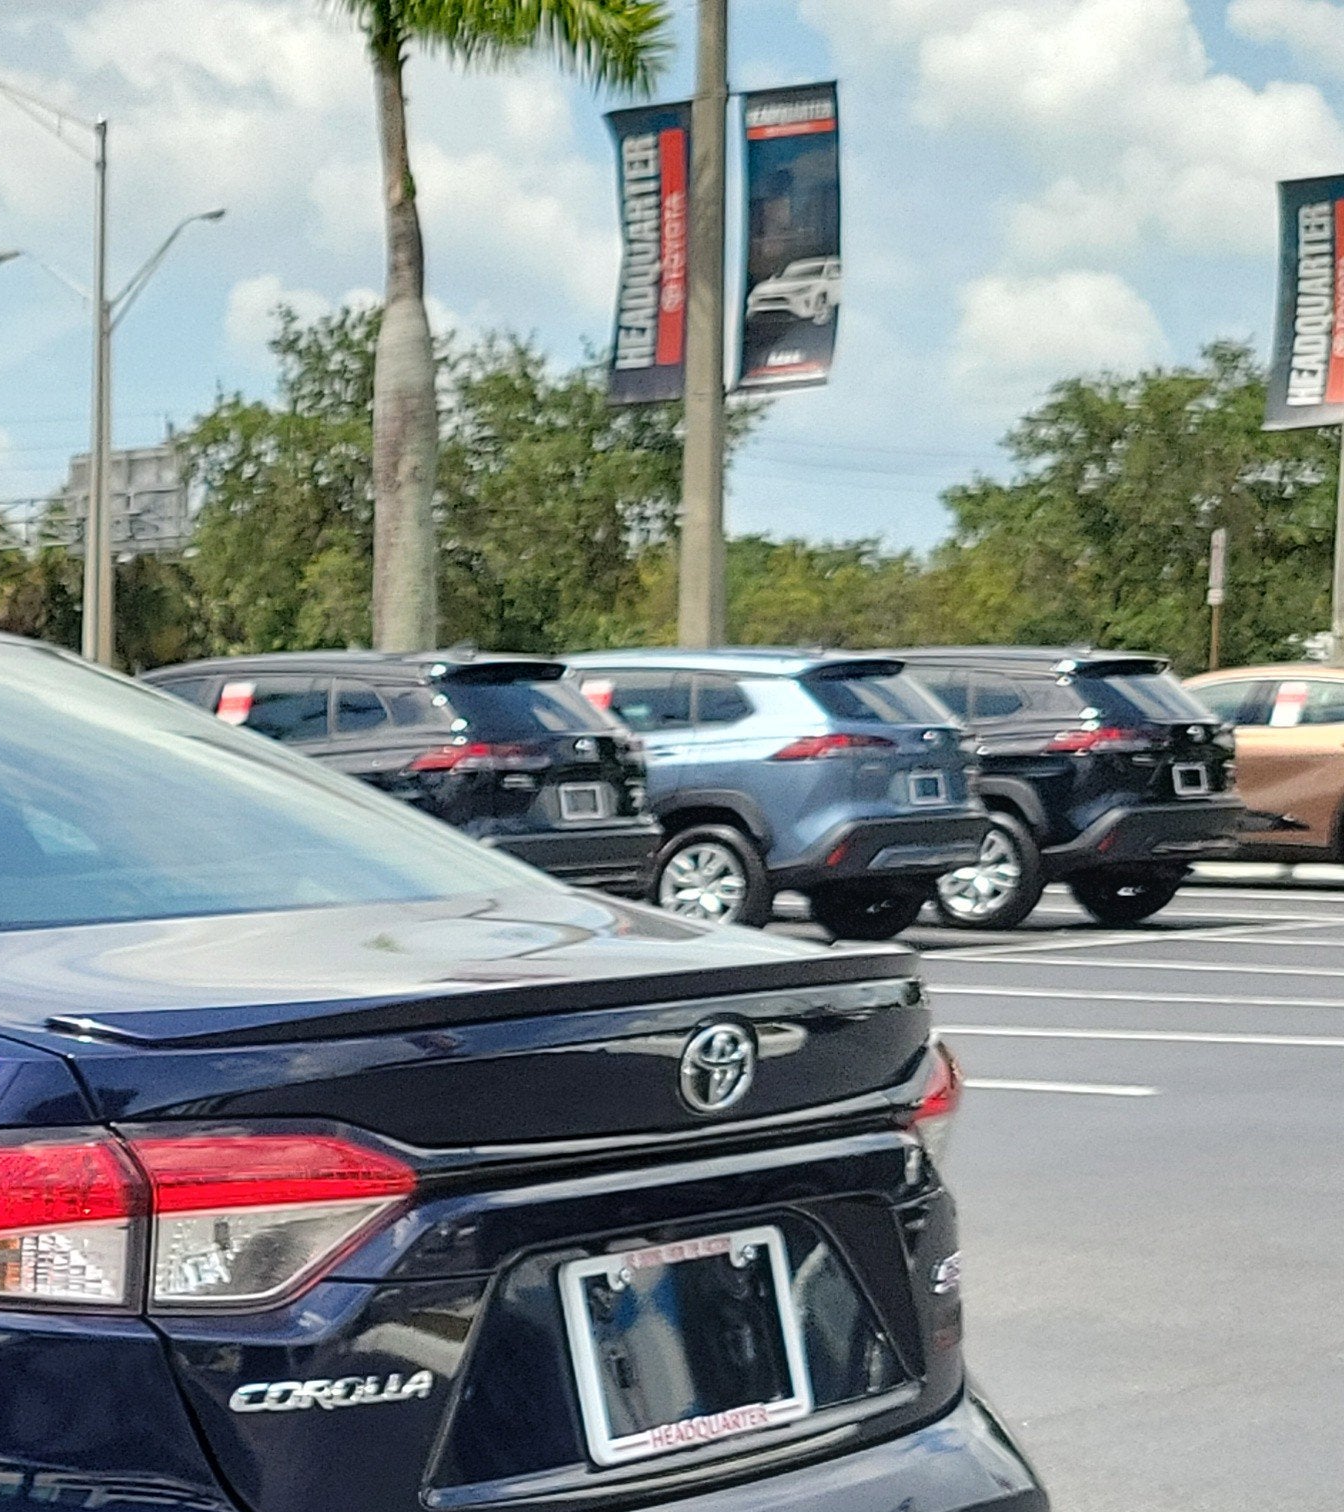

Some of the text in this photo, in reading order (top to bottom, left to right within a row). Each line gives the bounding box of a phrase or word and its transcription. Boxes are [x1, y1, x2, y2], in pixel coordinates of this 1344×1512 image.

[615, 131, 661, 369] HEADQUARTER
[1286, 200, 1333, 405] HEADQUARTER
[229, 1370, 433, 1412] COROLLA
[649, 1405, 769, 1448] HEADQUARTER
